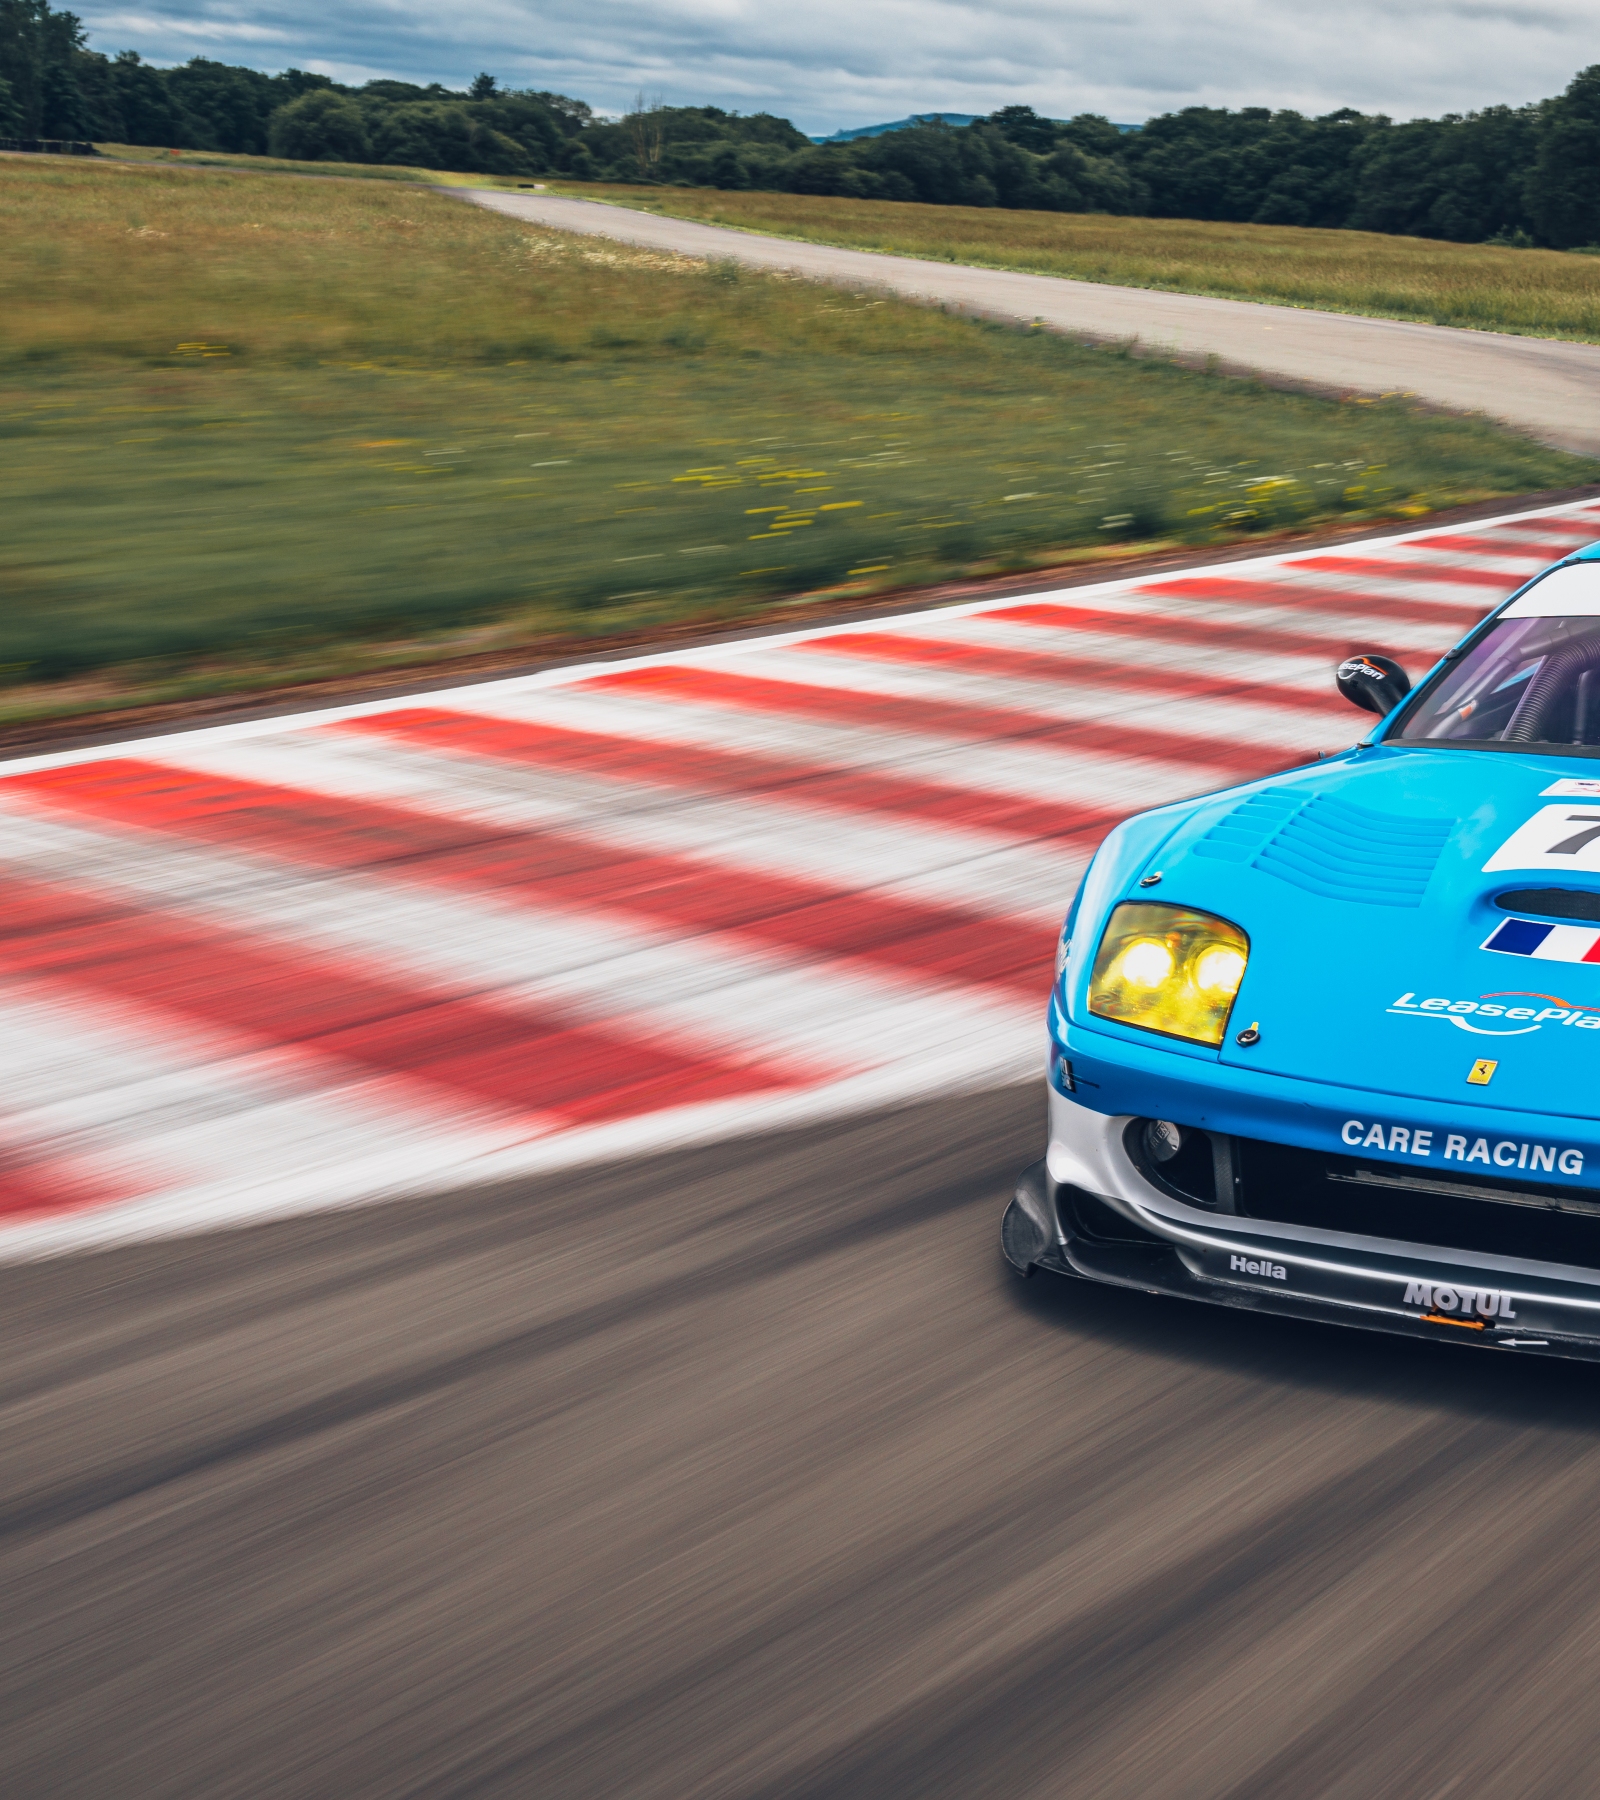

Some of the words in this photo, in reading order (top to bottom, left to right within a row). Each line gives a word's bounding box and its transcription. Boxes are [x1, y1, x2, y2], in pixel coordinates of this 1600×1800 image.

[1341, 1120, 1433, 1156] CARE
[1443, 1134, 1584, 1175] RACING
[1230, 1254, 1287, 1280] Hella
[1403, 1282, 1516, 1319] MOTUL
